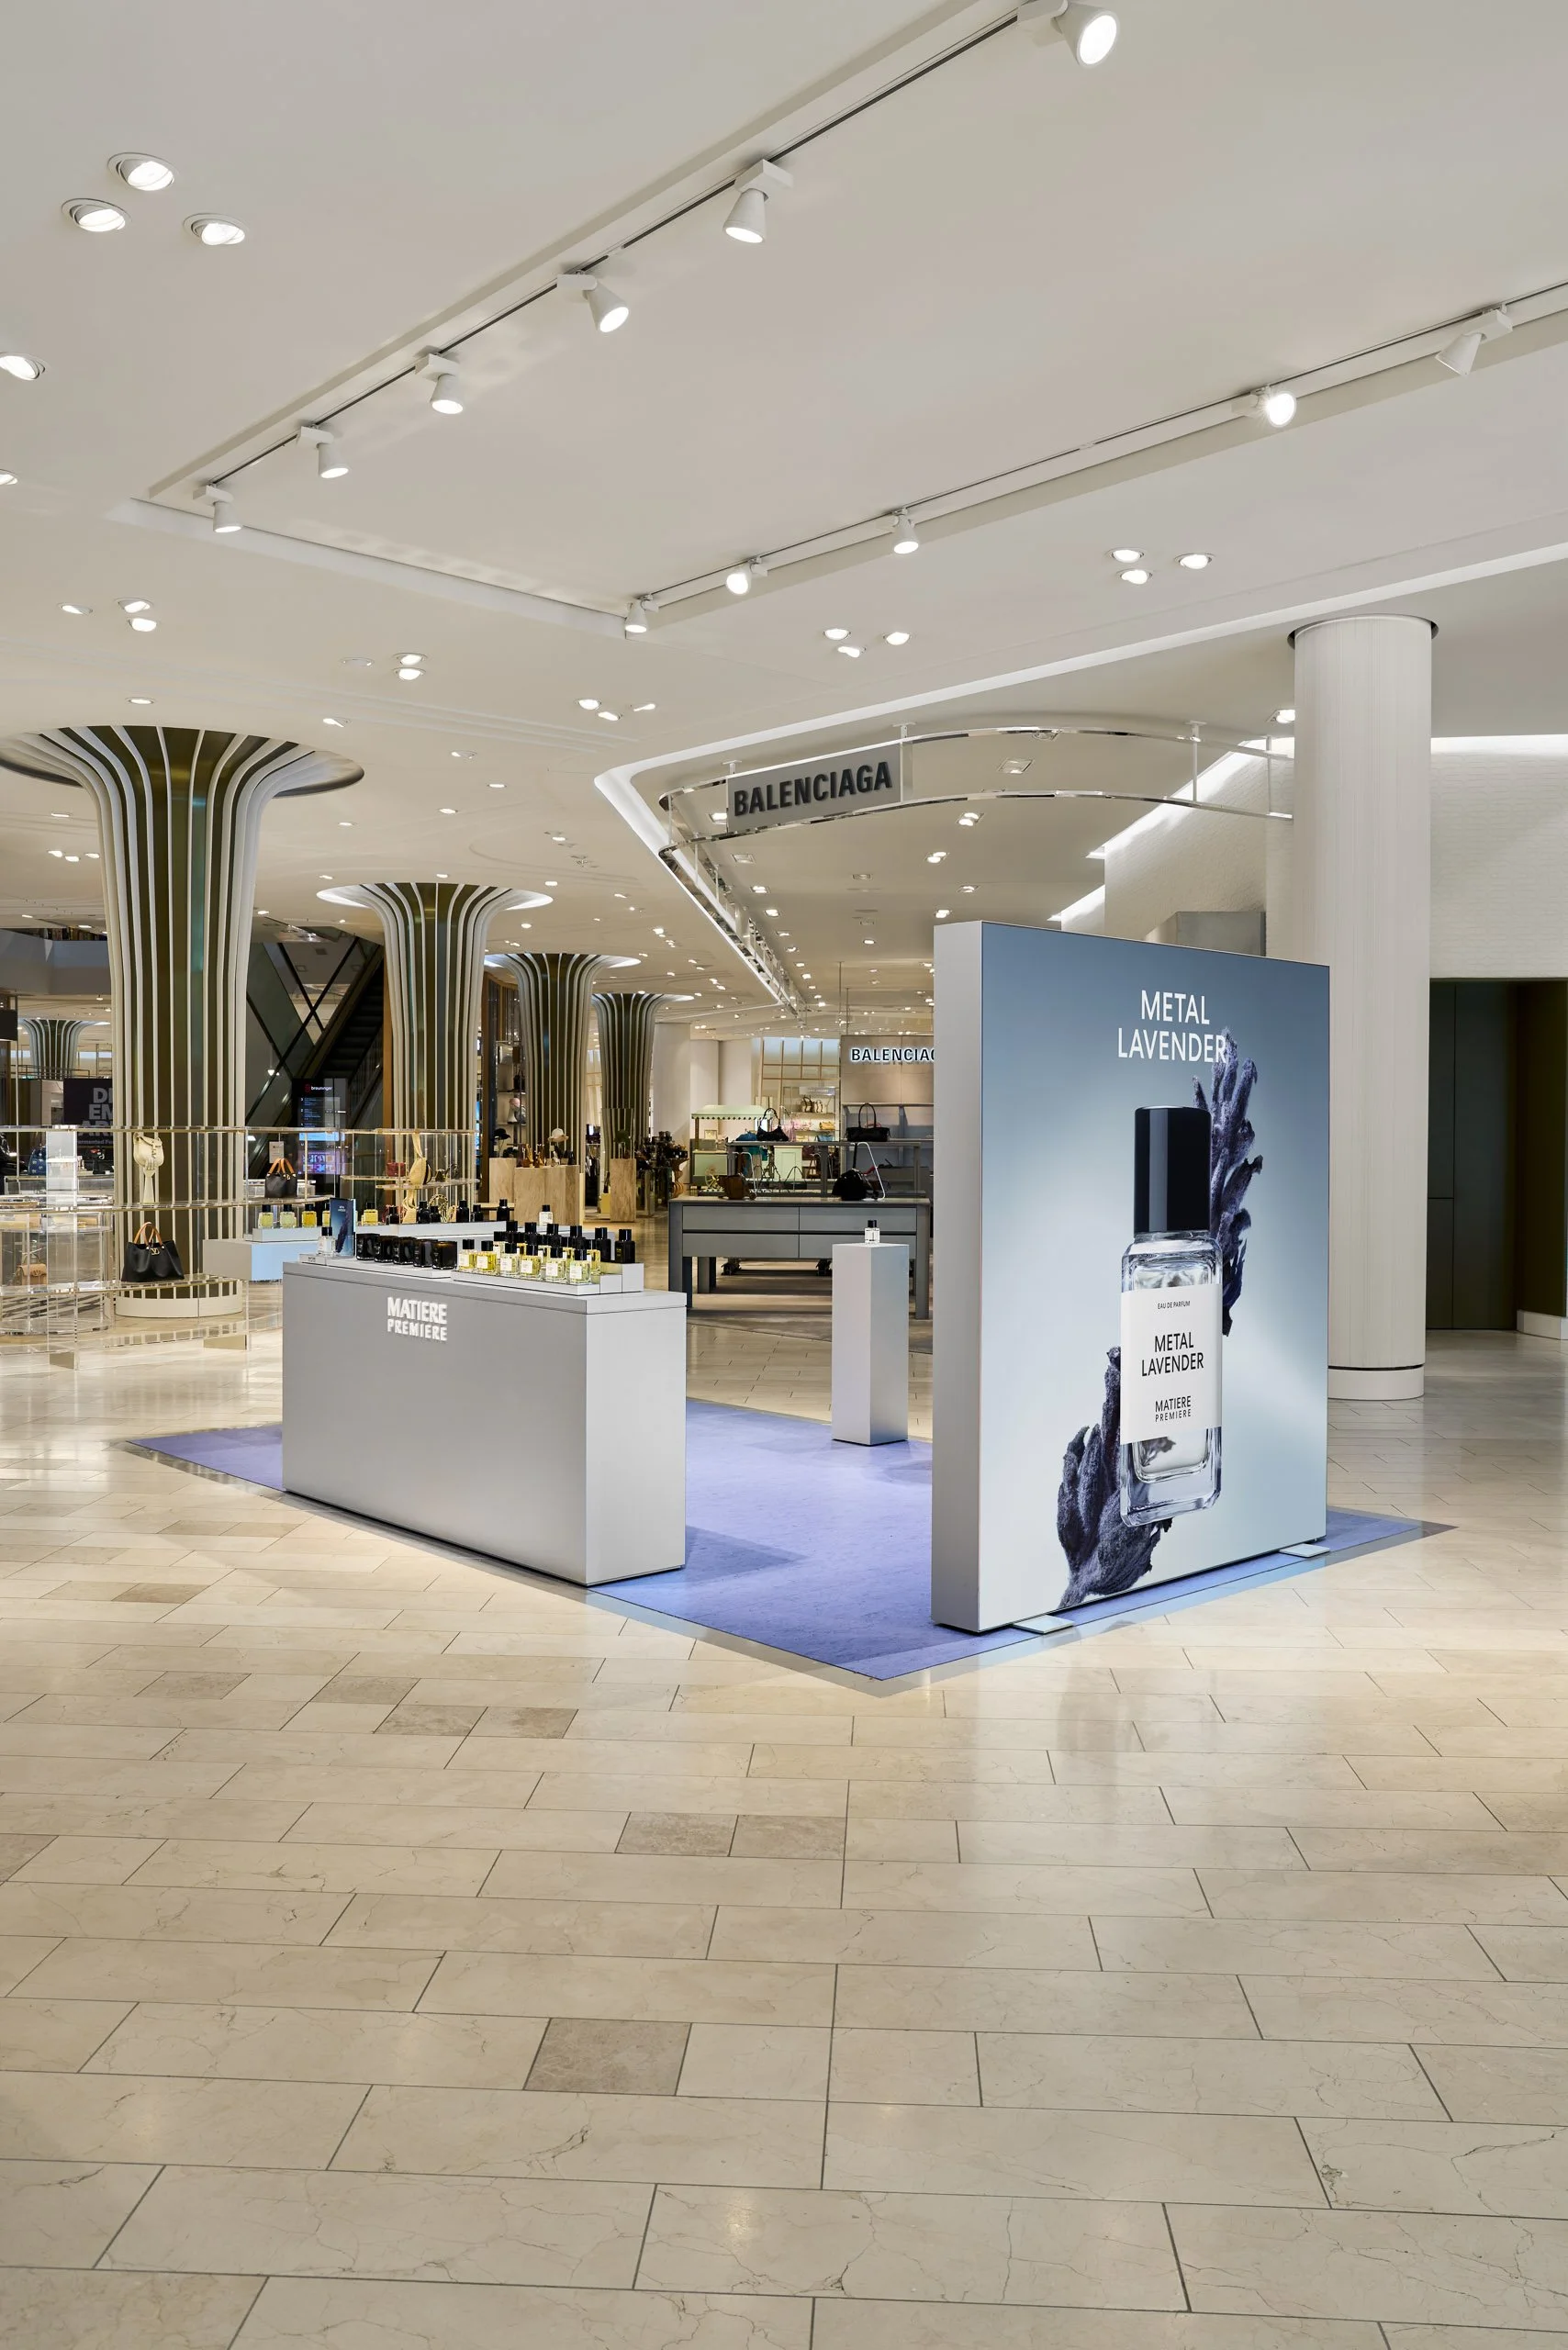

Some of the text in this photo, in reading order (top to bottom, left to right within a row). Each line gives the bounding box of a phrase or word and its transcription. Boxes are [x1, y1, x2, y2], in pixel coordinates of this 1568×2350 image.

[734, 761, 893, 816] BALENCIAGA
[1141, 990, 1210, 1024] METAL
[1118, 1027, 1227, 1063] LAVENDER
[387, 1296, 448, 1325] MATIERE
[1158, 1302, 1166, 1310] EAU
[1173, 1300, 1191, 1308] PARFUM
[387, 1318, 448, 1341] PREMIERE
[1154, 1331, 1194, 1353] METAL
[1141, 1352, 1204, 1377] LAVENDER
[1155, 1395, 1192, 1413] MATIERE
[1155, 1408, 1192, 1422] PREMIERE
